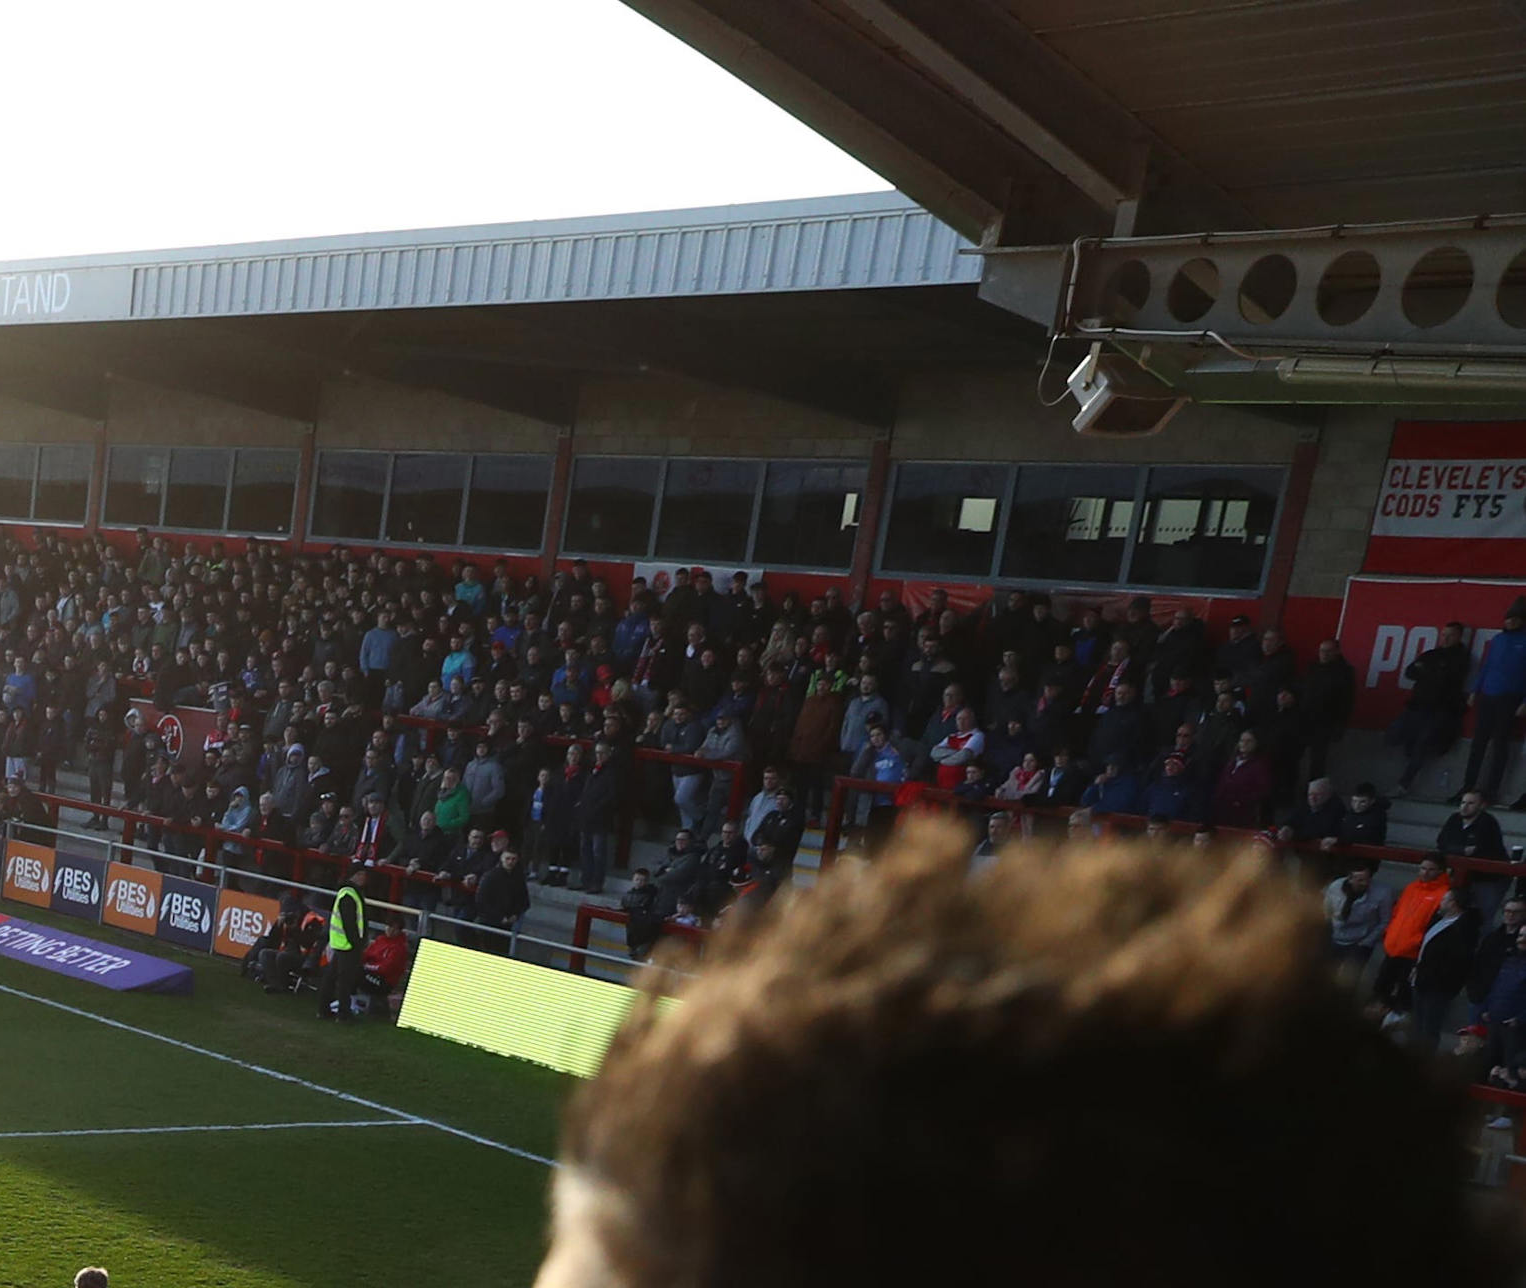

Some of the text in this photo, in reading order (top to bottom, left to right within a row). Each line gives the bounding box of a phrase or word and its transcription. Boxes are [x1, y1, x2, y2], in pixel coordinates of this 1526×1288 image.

[1388, 465, 1526, 490] CLEVELEYS
[1381, 493, 1443, 518] CODS
[1452, 494, 1507, 519] FY5
[15, 856, 42, 880] BES
[63, 867, 92, 892] BES
[117, 879, 147, 905] BES
[116, 901, 144, 918] Utilities
[172, 893, 202, 920] BES
[170, 913, 200, 933] Utilities
[231, 907, 263, 935] BES
[46, 944, 131, 975] BETTER
